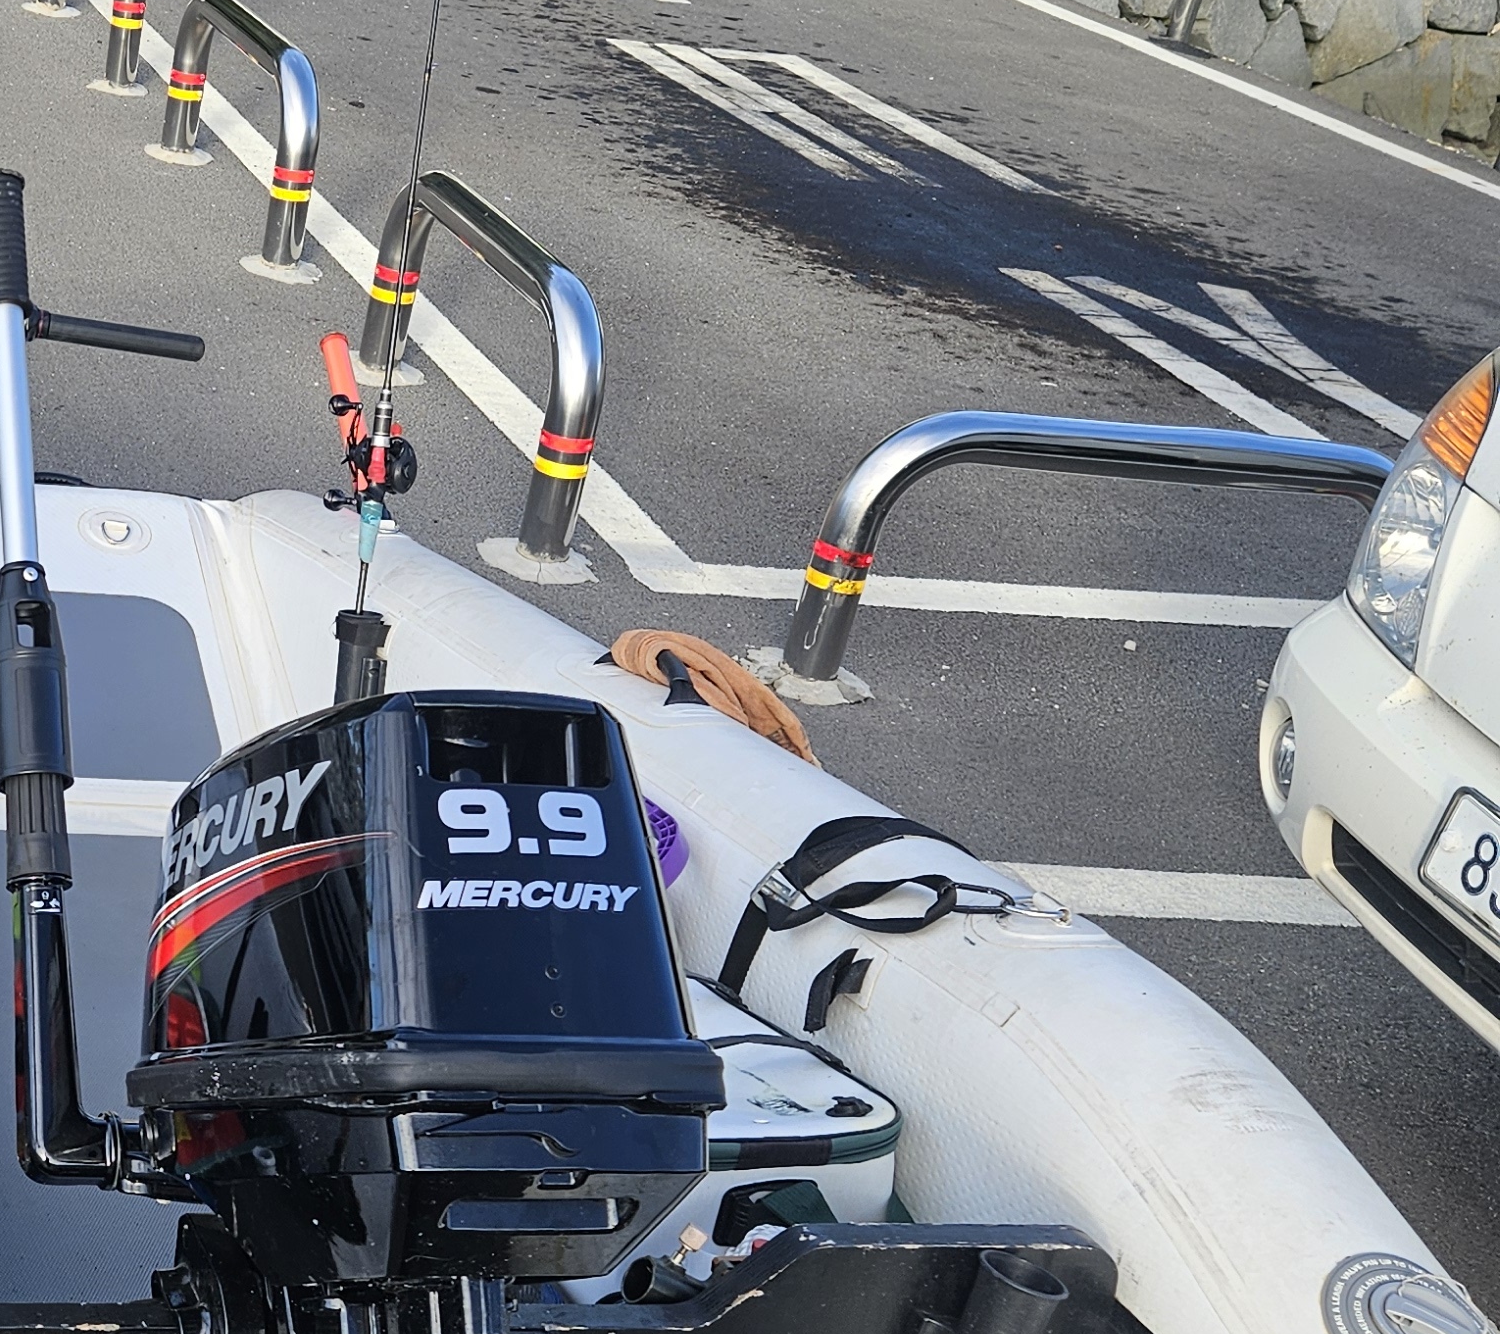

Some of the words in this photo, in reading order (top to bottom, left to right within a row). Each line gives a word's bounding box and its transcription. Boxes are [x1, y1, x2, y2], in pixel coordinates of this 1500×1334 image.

[162, 760, 332, 893] ERCURY
[437, 788, 607, 857] 9.9
[416, 880, 639, 912] MERCURY
[1461, 832, 1500, 919] 8
